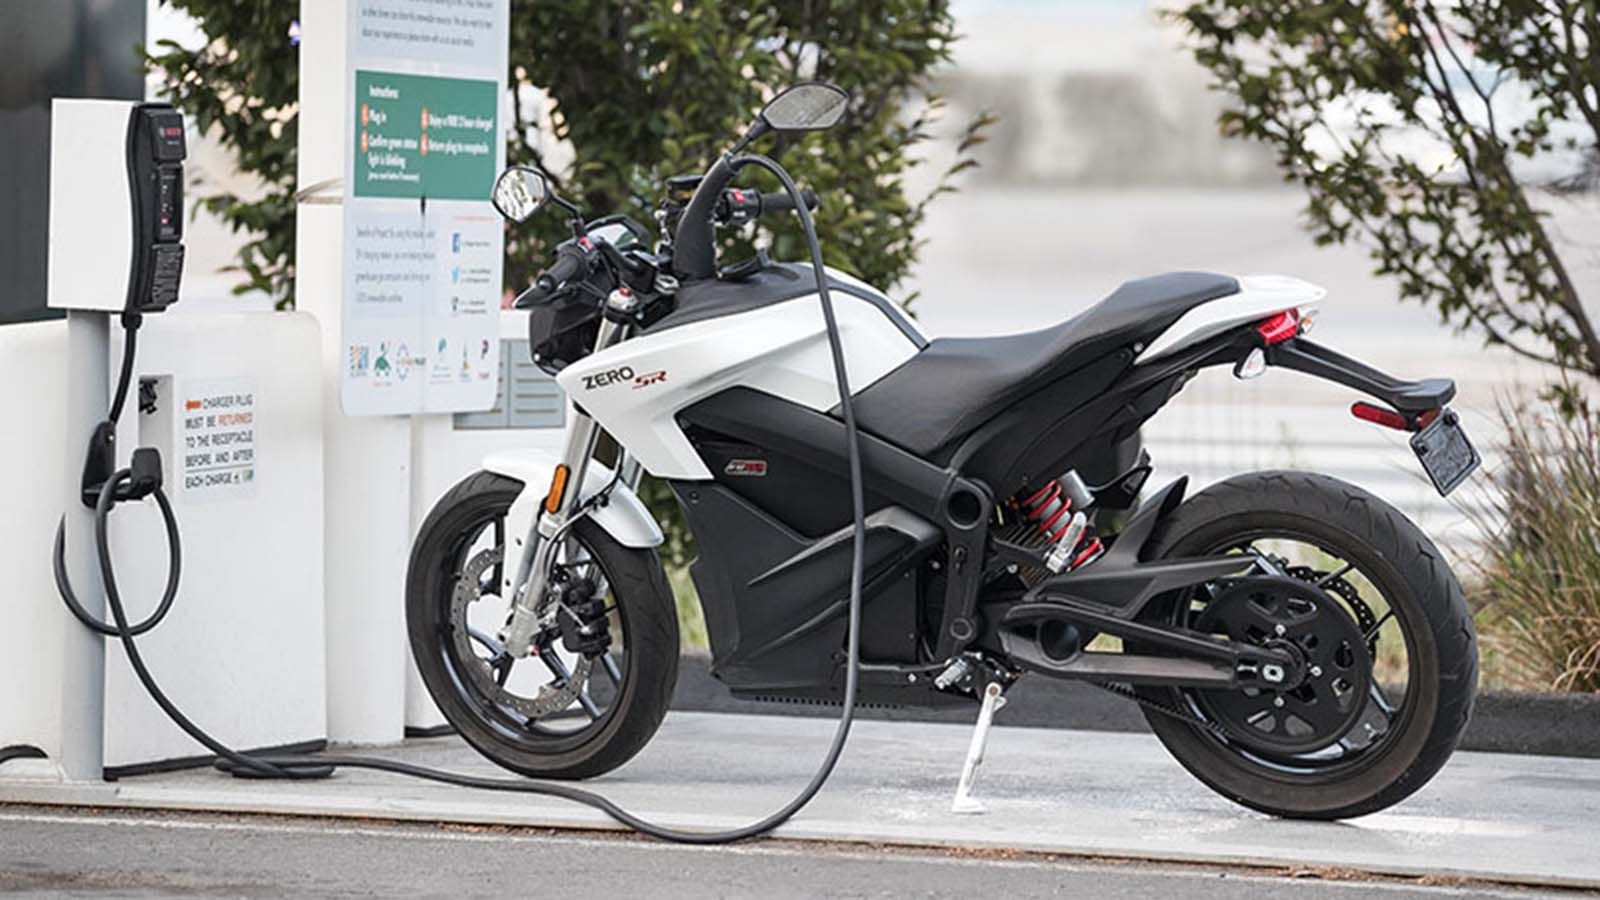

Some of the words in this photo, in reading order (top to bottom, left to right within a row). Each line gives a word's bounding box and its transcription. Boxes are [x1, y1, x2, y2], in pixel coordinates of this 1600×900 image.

[581, 366, 635, 390] ZERO
[632, 371, 666, 389] SR
[203, 396, 234, 410] CHARGER
[235, 394, 253, 406] PLUG
[185, 416, 203, 429] MUST
[206, 415, 216, 427] BE
[218, 412, 253, 426] RETURNED
[185, 436, 195, 448] TO
[197, 435, 209, 447] THE
[212, 430, 253, 445] RECEPTACLE
[185, 454, 211, 467] BEFORE
[215, 451, 230, 463] AND
[232, 449, 253, 461] AFTER
[185, 476, 203, 489] EACH
[205, 472, 232, 486] CHARGE
